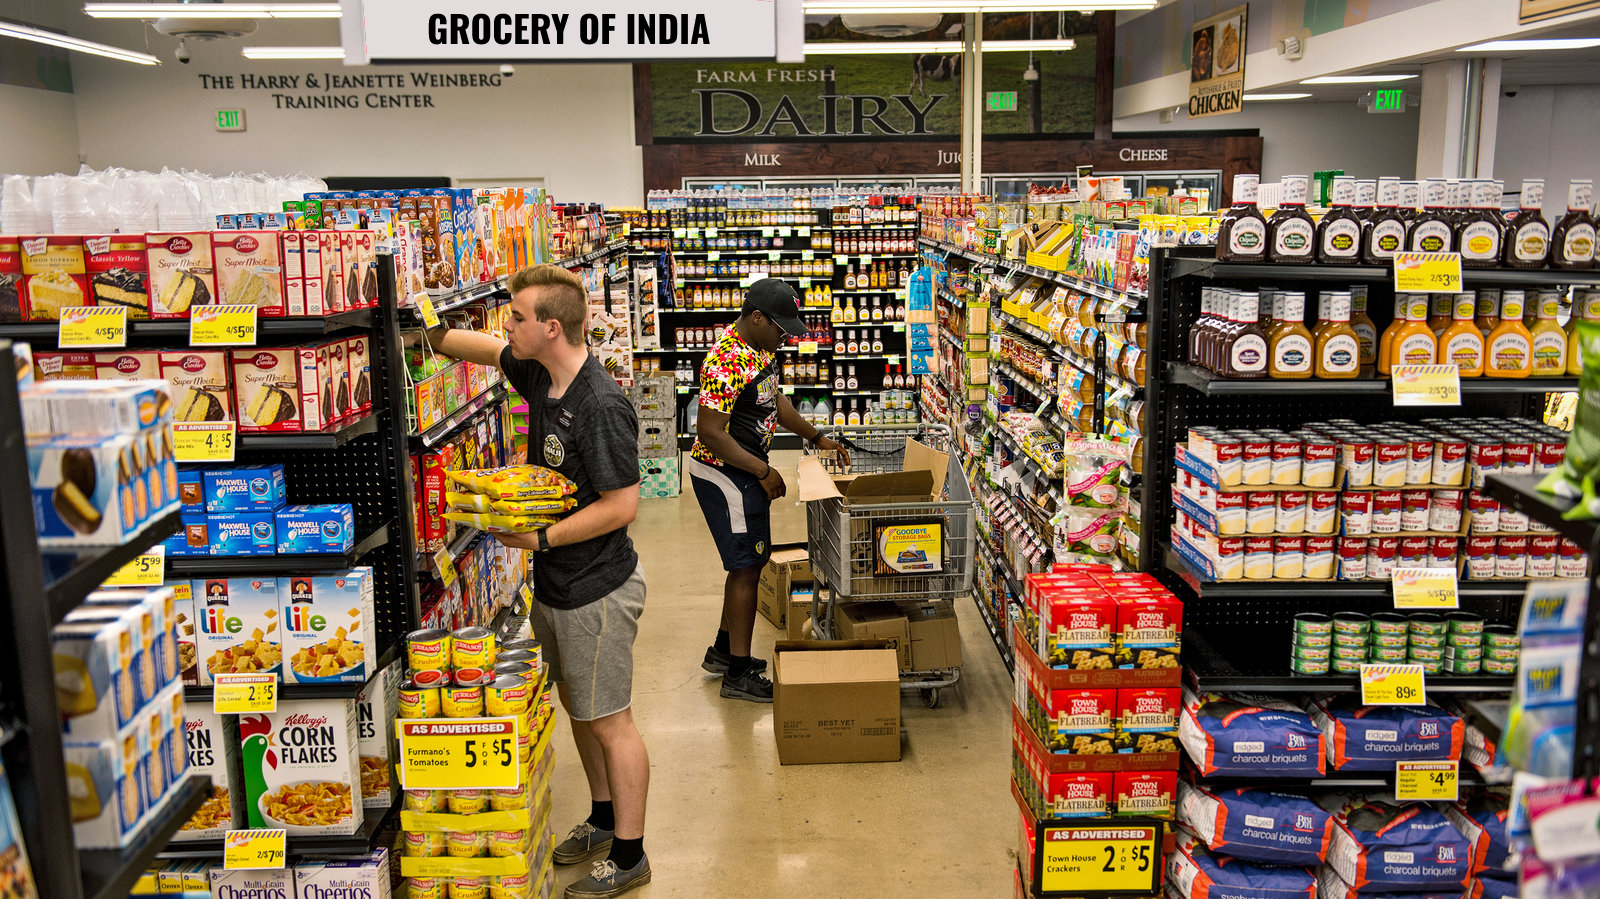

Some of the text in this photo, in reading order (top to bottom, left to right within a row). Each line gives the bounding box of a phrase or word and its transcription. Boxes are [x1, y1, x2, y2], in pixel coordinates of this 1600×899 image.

[428, 13, 710, 45] GROCERY OF INDIA
[696, 68, 836, 84] FARM FRESH
[199, 72, 502, 92] THE HARRY & JEANETTE WEINBERG
[272, 93, 435, 110] TRAINING CENTER
[992, 92, 1015, 110] EXIT
[1188, 89, 1241, 117] CHICKEN
[1375, 89, 1403, 110] EXIT
[691, 88, 949, 137] DAIRY
[218, 110, 239, 128] EXIT
[744, 153, 782, 167] MILK
[936, 150, 963, 167] JUI
[1119, 148, 1168, 163] CHEESE
[90, 255, 141, 263] Classic Yellow
[205, 432, 232, 449] 4 $5
[216, 478, 248, 487] MAXWELL
[226, 485, 249, 493] HOUSE
[219, 522, 250, 531] MAXWELL
[287, 521, 320, 529] MAXWELL
[297, 526, 321, 535] HOUSE
[229, 529, 251, 537] HOUSE
[896, 527, 928, 536] GOODBYE
[200, 608, 243, 634] life
[286, 605, 327, 633] life
[1070, 613, 1097, 621] TOWN
[1137, 612, 1164, 621] TOWN
[1070, 620, 1099, 628] HOUSE
[1136, 619, 1164, 628] HOUSE
[1059, 630, 1109, 641] FLATBREAD
[1125, 630, 1175, 640] FLATBREAD
[248, 686, 256, 701] 2
[1071, 699, 1098, 707] TOWN
[1135, 697, 1162, 705] TOWN
[1071, 706, 1099, 714] HOUSE
[1135, 704, 1163, 713] HOUSE
[285, 713, 328, 729] Kellogg's
[1060, 716, 1109, 727] FLATBREAD
[1124, 714, 1173, 725] FLATBREAD
[411, 723, 505, 735] AS ADVERTISED
[279, 726, 335, 747] CORN
[1367, 731, 1396, 741] ridged
[407, 747, 451, 757] Furmano's
[465, 740, 477, 768] 5
[492, 738, 512, 767] $5
[1235, 743, 1262, 752] ridged
[1364, 742, 1440, 753] charcoal briquets
[281, 746, 337, 764] FLAKES
[1232, 754, 1308, 765] charcoal briquets
[408, 758, 449, 767] Tomatoes
[1067, 783, 1094, 791] TOWN
[1131, 782, 1158, 790] TOWN
[1067, 790, 1095, 799] HOUSE
[1131, 788, 1159, 797] HOUSE
[1056, 800, 1105, 810] FLATBREAD
[1120, 798, 1169, 808] FLATBREAD
[1246, 817, 1274, 828] ridged
[1053, 830, 1146, 840] AS ADVERTISED
[1242, 828, 1312, 845] charcoal briquets
[1048, 855, 1069, 863] Town
[1102, 845, 1115, 873] 2
[1131, 845, 1150, 873] $5
[1385, 853, 1413, 863] ridged
[1383, 865, 1457, 877] charcoal briquets
[218, 884, 287, 899] Cheerios
[303, 884, 372, 899] Cheerios
